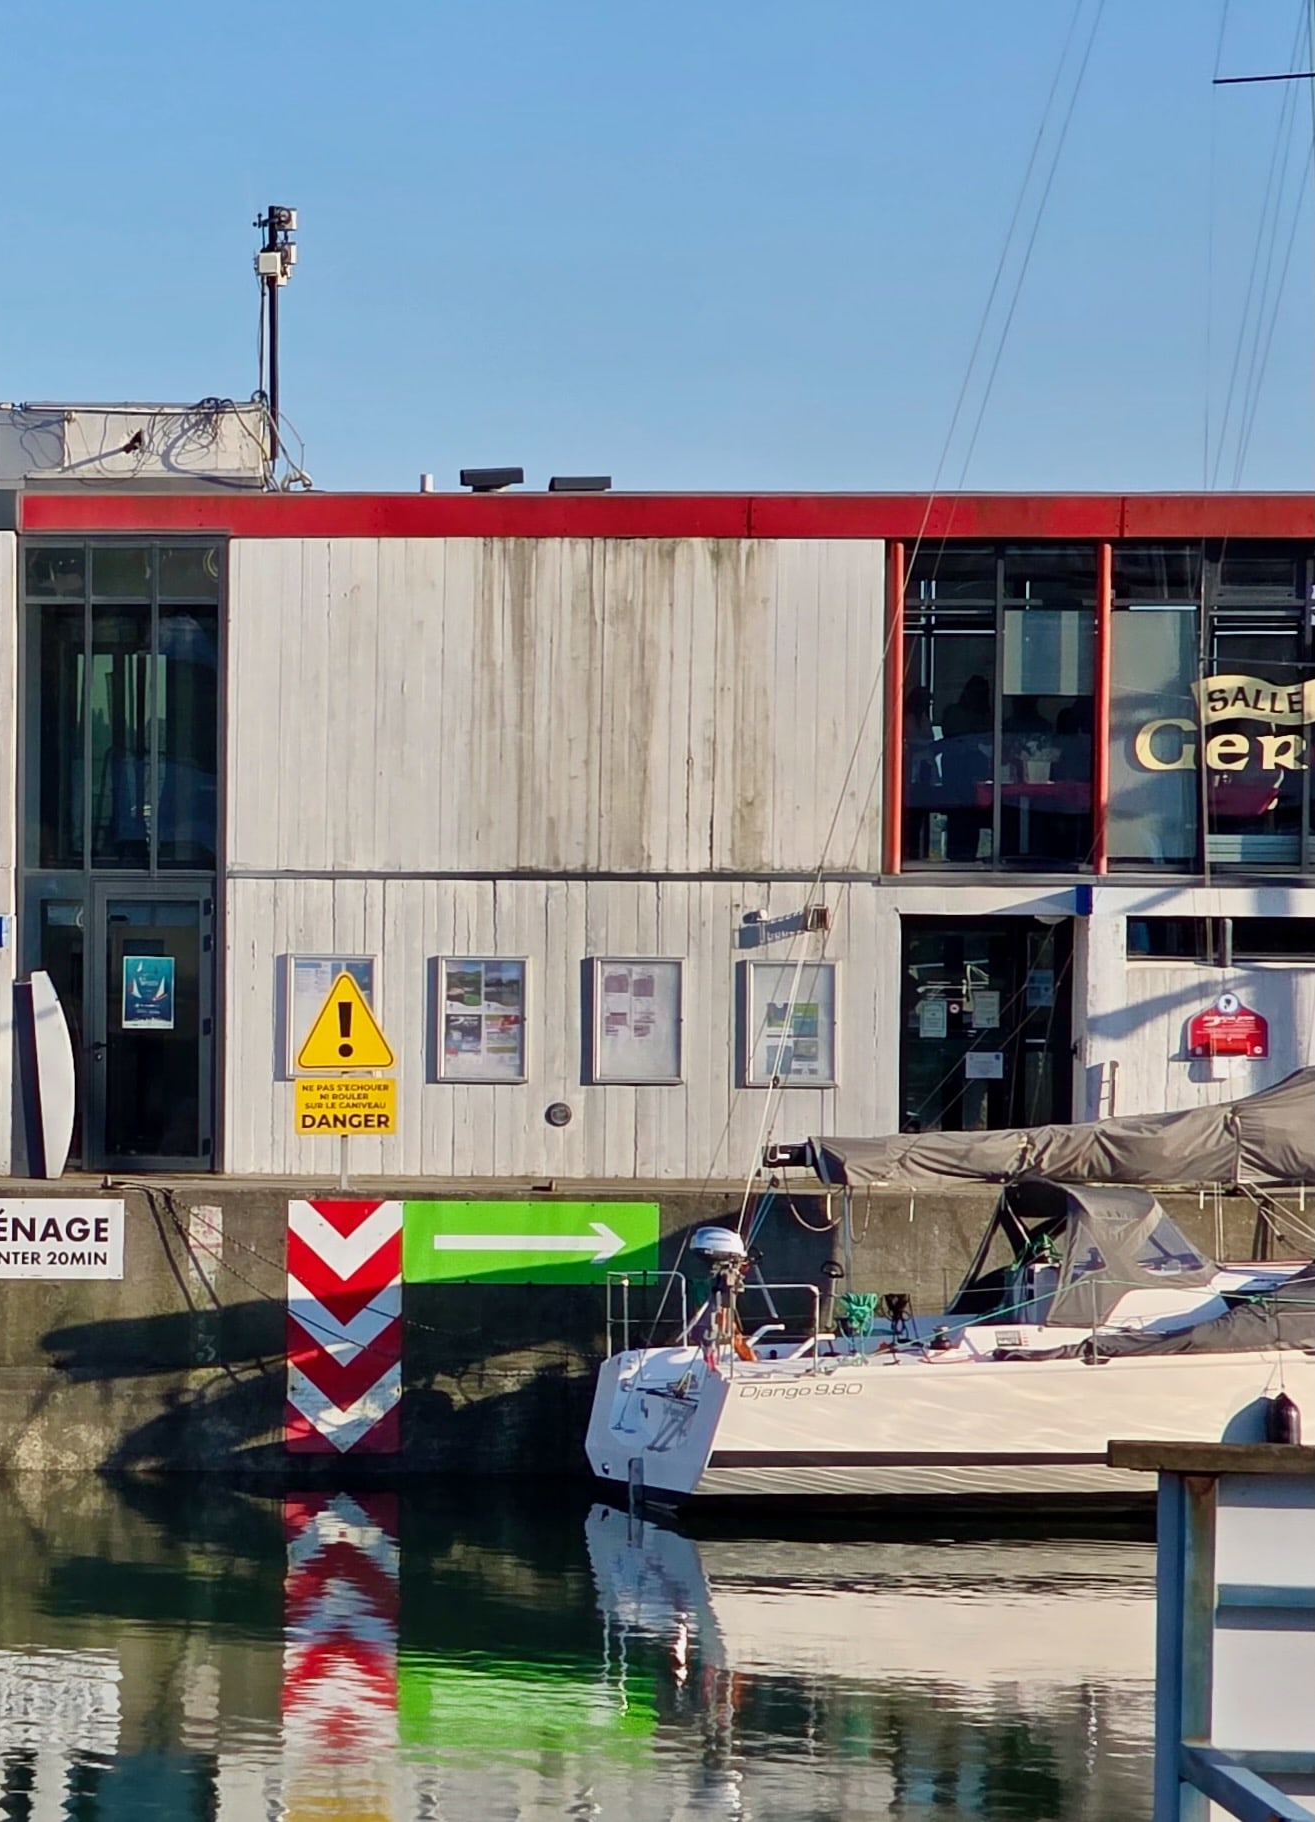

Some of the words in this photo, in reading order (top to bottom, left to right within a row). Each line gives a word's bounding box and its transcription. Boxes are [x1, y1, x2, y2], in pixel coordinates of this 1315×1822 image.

[1207, 686, 1302, 714] SALLE
[302, 1084, 314, 1092] NE
[316, 1084, 335, 1092] PAS
[304, 1102, 323, 1110] SUR
[301, 1113, 390, 1129] DANGER
[46, 1251, 108, 1266] 20MIN
[739, 1385, 811, 1400] Django
[814, 1383, 863, 1396] 9.80
